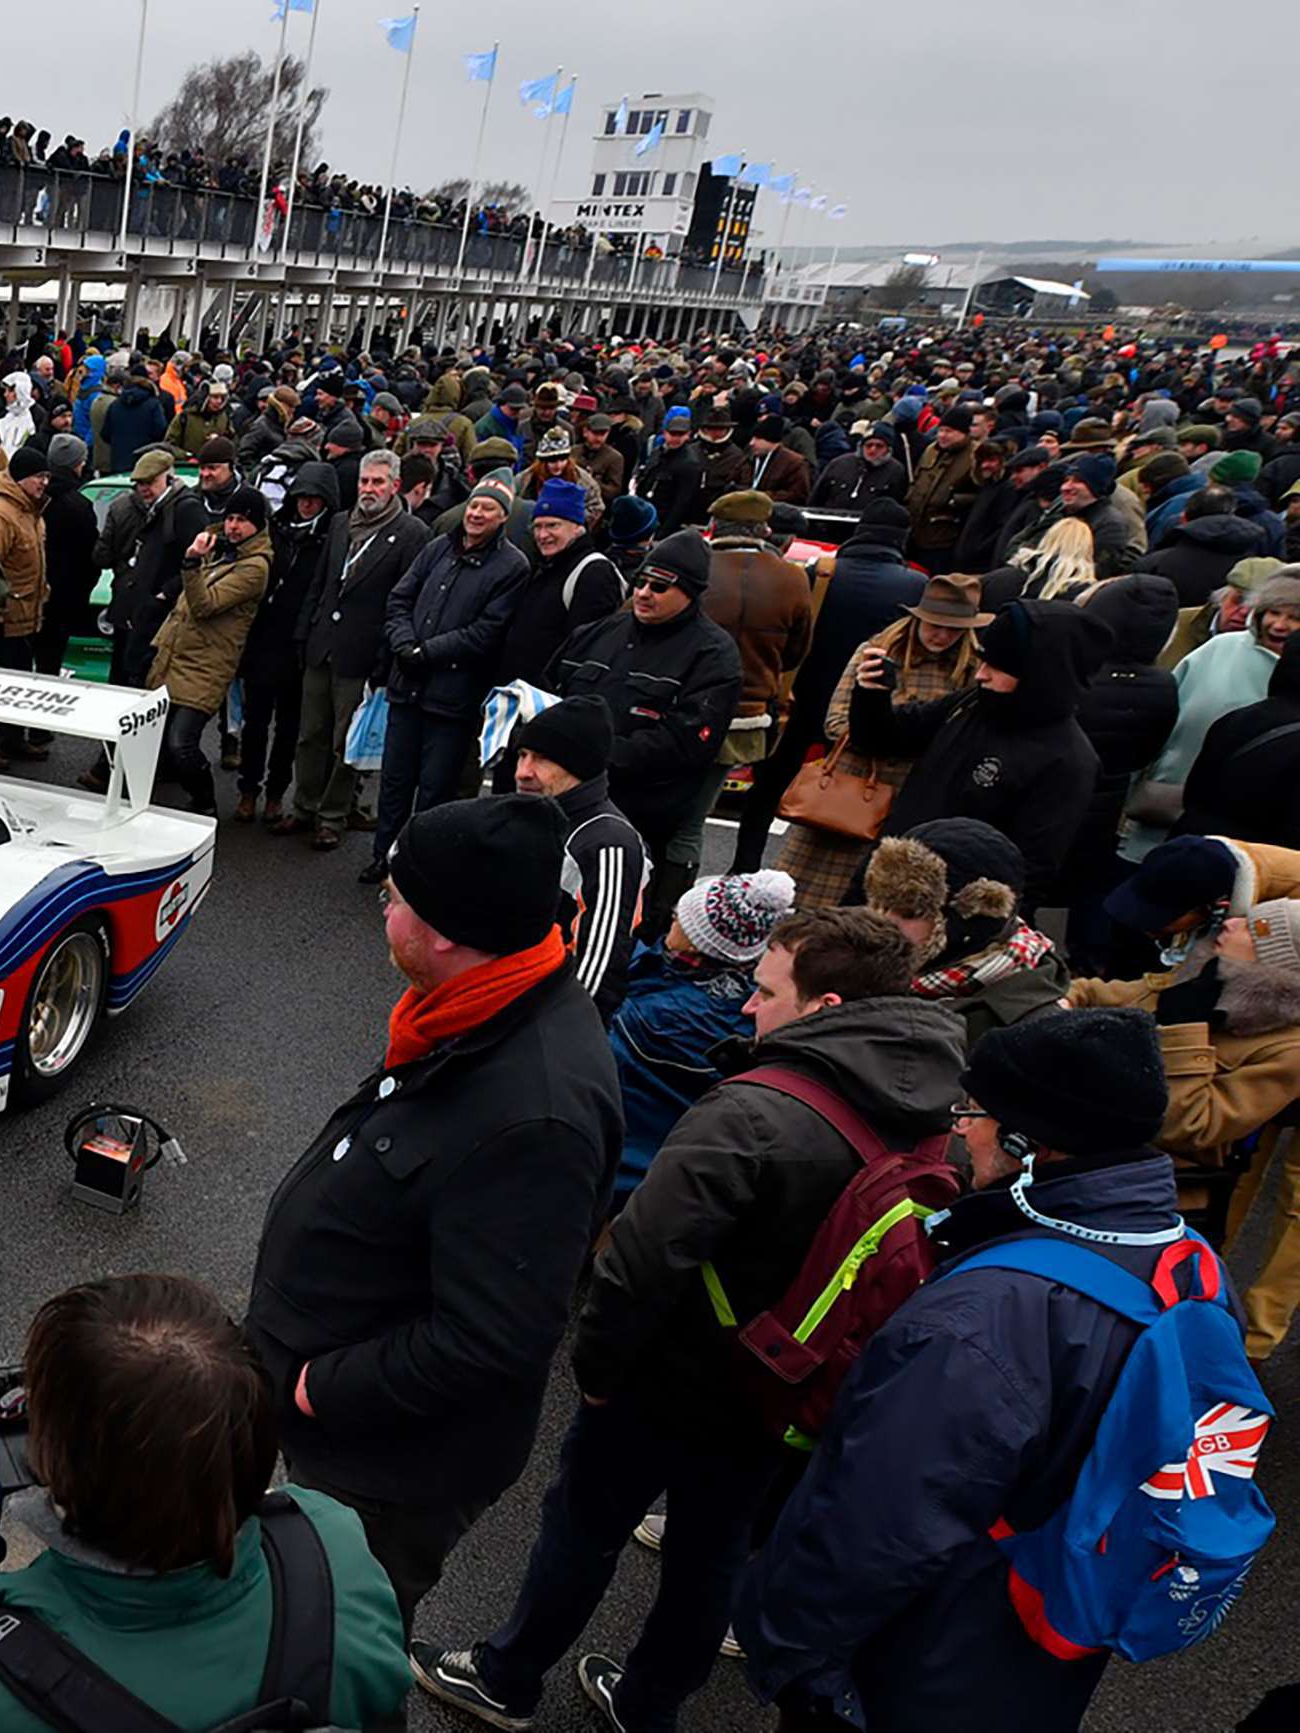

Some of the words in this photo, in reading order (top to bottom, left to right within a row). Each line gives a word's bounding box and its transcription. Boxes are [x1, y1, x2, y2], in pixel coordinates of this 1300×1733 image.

[577, 204, 645, 217] MINTEX
[35, 249, 43, 263] 3
[115, 254, 124, 268] 4
[187, 258, 194, 272] 5
[118, 698, 168, 736] Shell
[1197, 1434, 1231, 1454] GB
